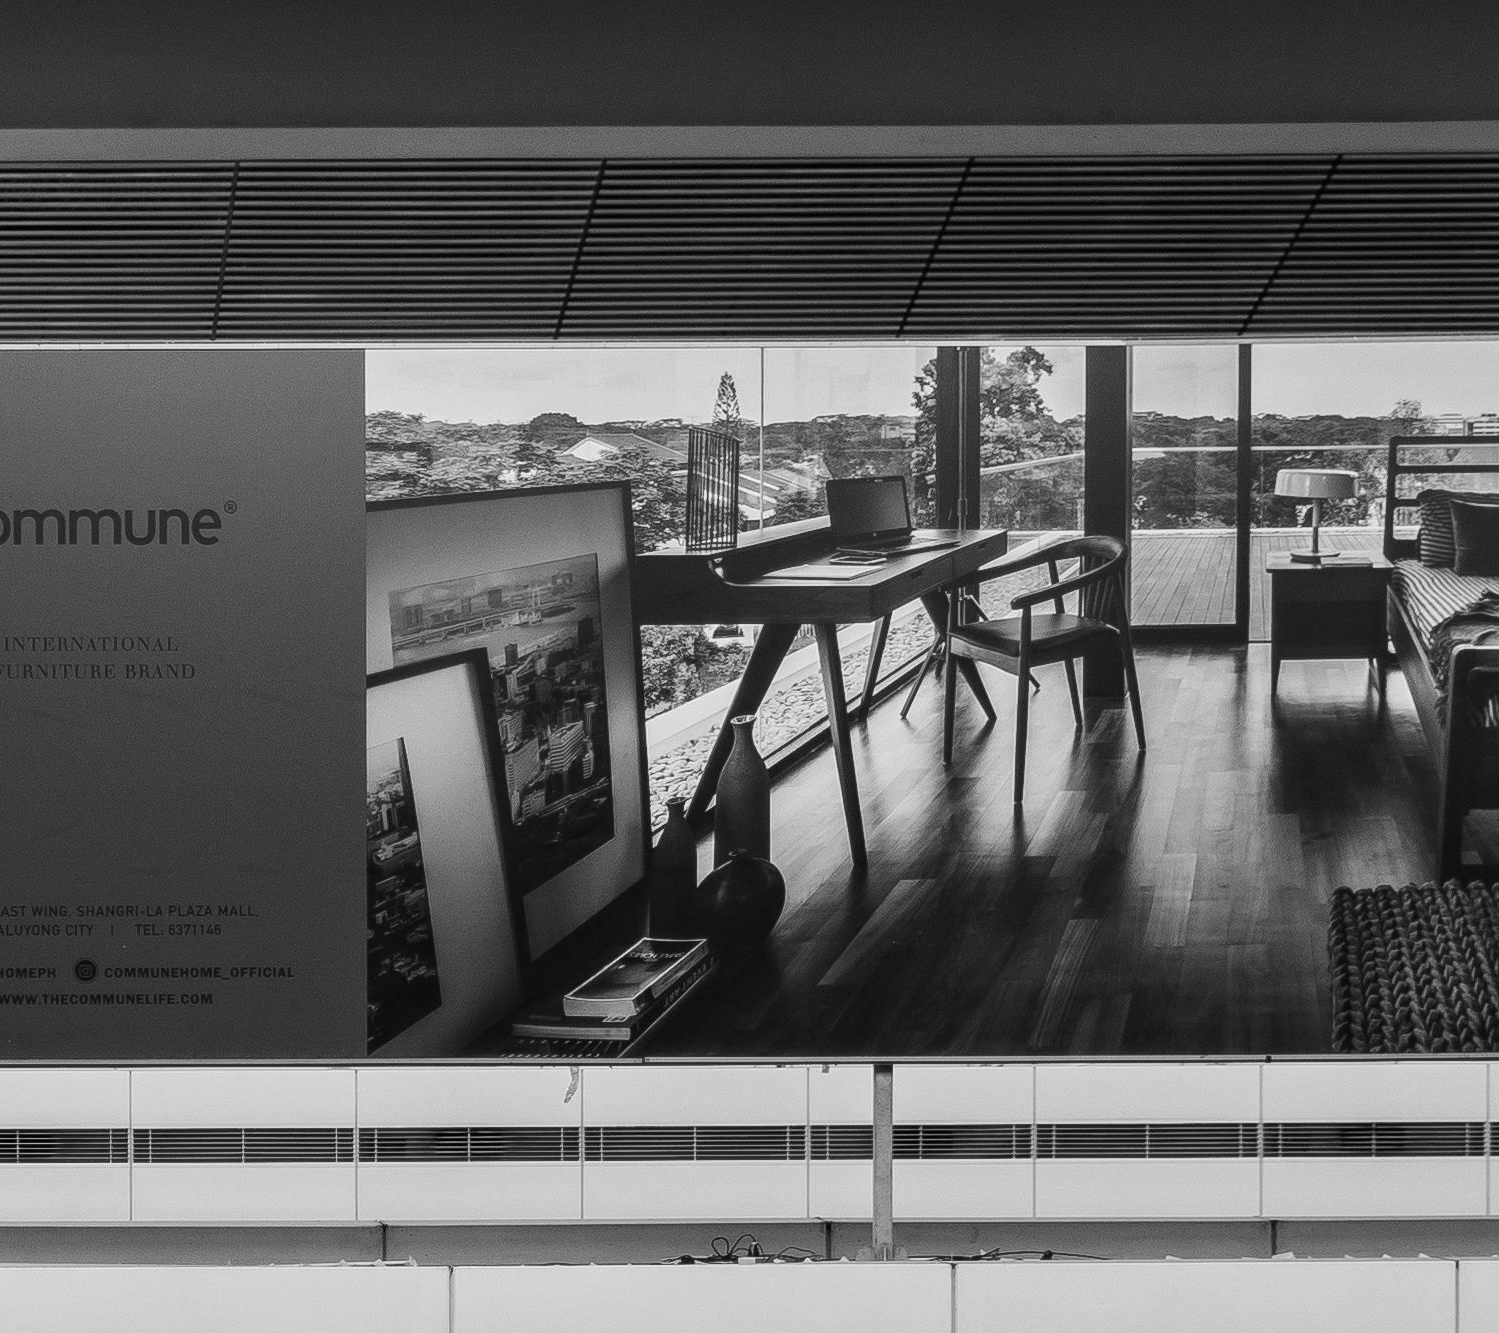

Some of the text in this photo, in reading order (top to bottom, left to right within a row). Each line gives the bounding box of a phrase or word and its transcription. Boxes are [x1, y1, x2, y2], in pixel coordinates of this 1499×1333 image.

[4, 636, 179, 653] INTERNATIONAL
[125, 664, 196, 680] BRAND
[77, 904, 163, 918] SHANGRI-LA
[168, 904, 213, 917] PLAZA
[65, 924, 94, 937] CITY
[135, 924, 163, 937] TEL:
[168, 924, 222, 937] 6371146
[104, 966, 295, 981] COMMUNEHOME_OFFICIAL
